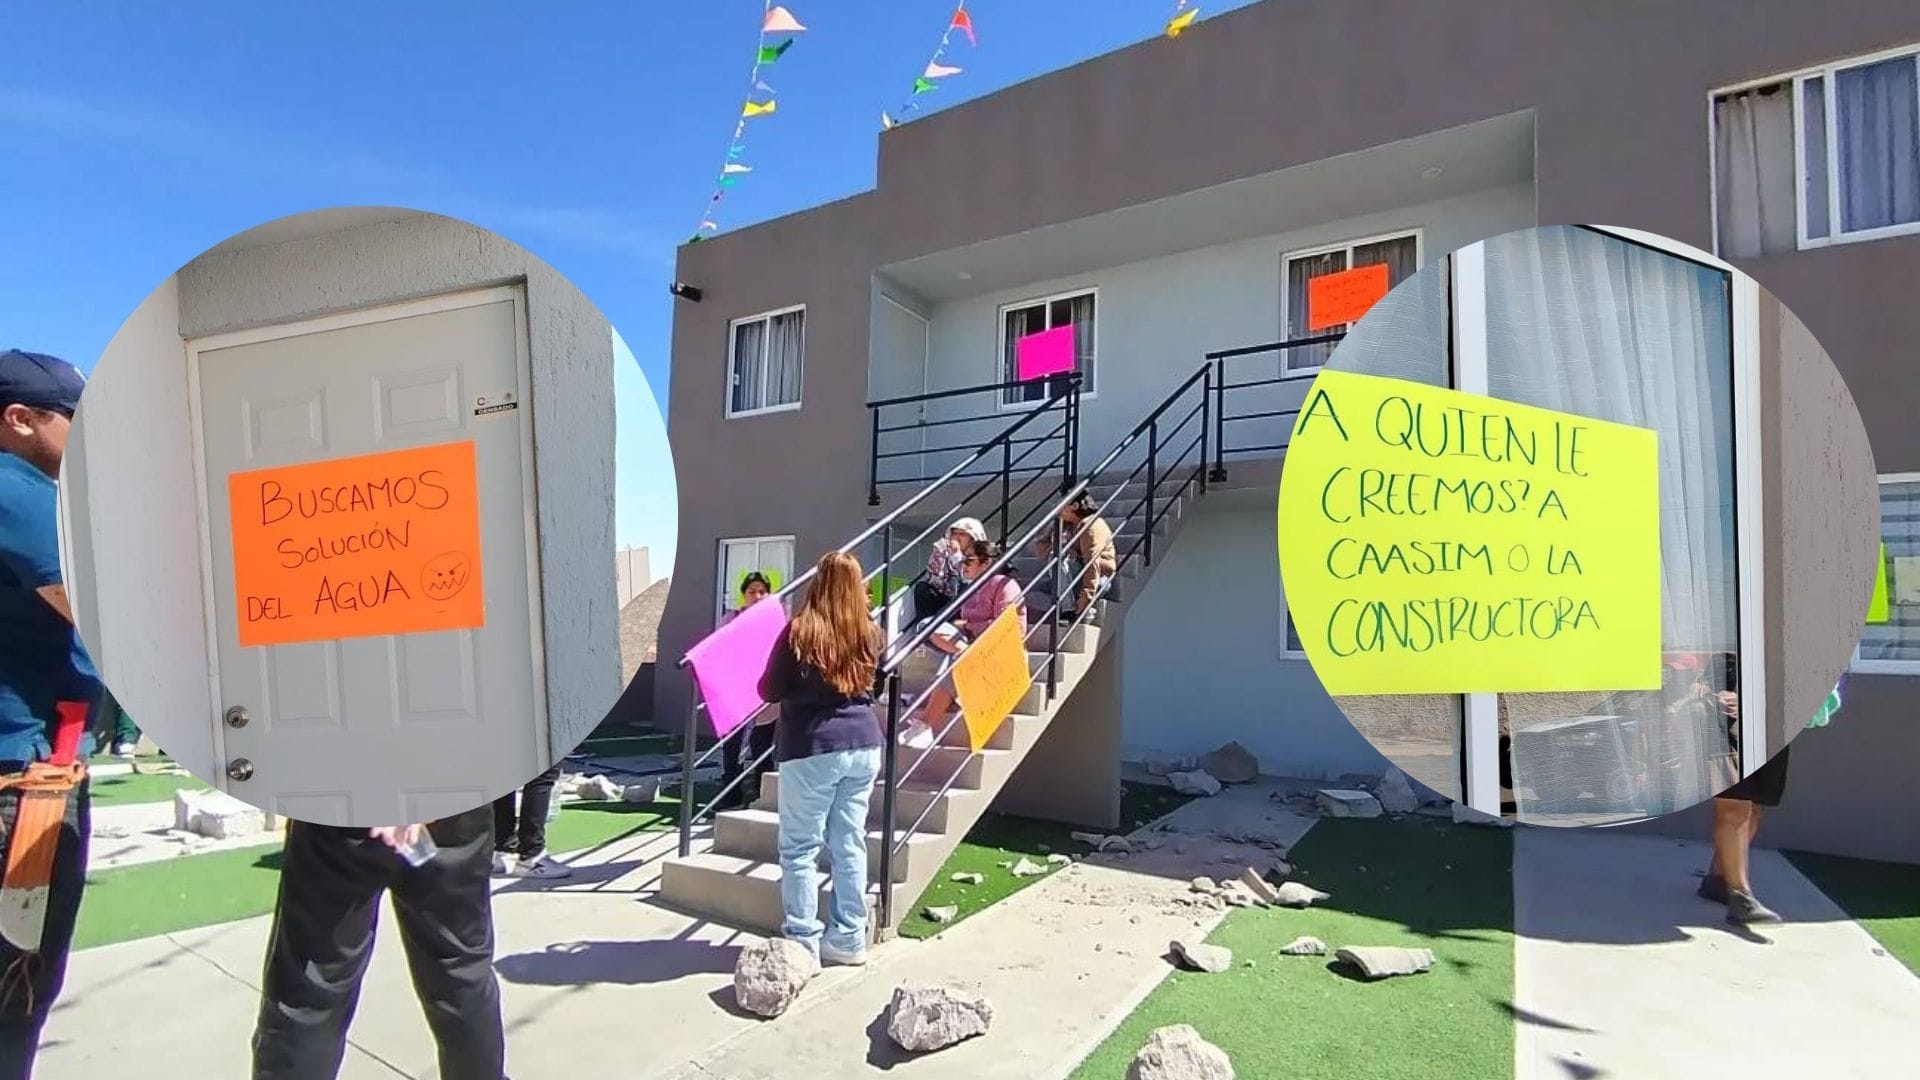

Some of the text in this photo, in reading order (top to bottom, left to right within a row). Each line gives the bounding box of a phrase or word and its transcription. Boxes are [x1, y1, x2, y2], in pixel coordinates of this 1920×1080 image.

[1296, 389, 1589, 478] A QUIEN LE
[261, 470, 449, 527] BUSCAMOS
[1321, 466, 1569, 523] CREEMOS? A
[277, 519, 411, 569] SOLUCIÓN
[1326, 537, 1582, 580] CAASIM O LA
[247, 569, 411, 622] DEL AGUA
[1327, 595, 1601, 658] CONSTRUCTORA
